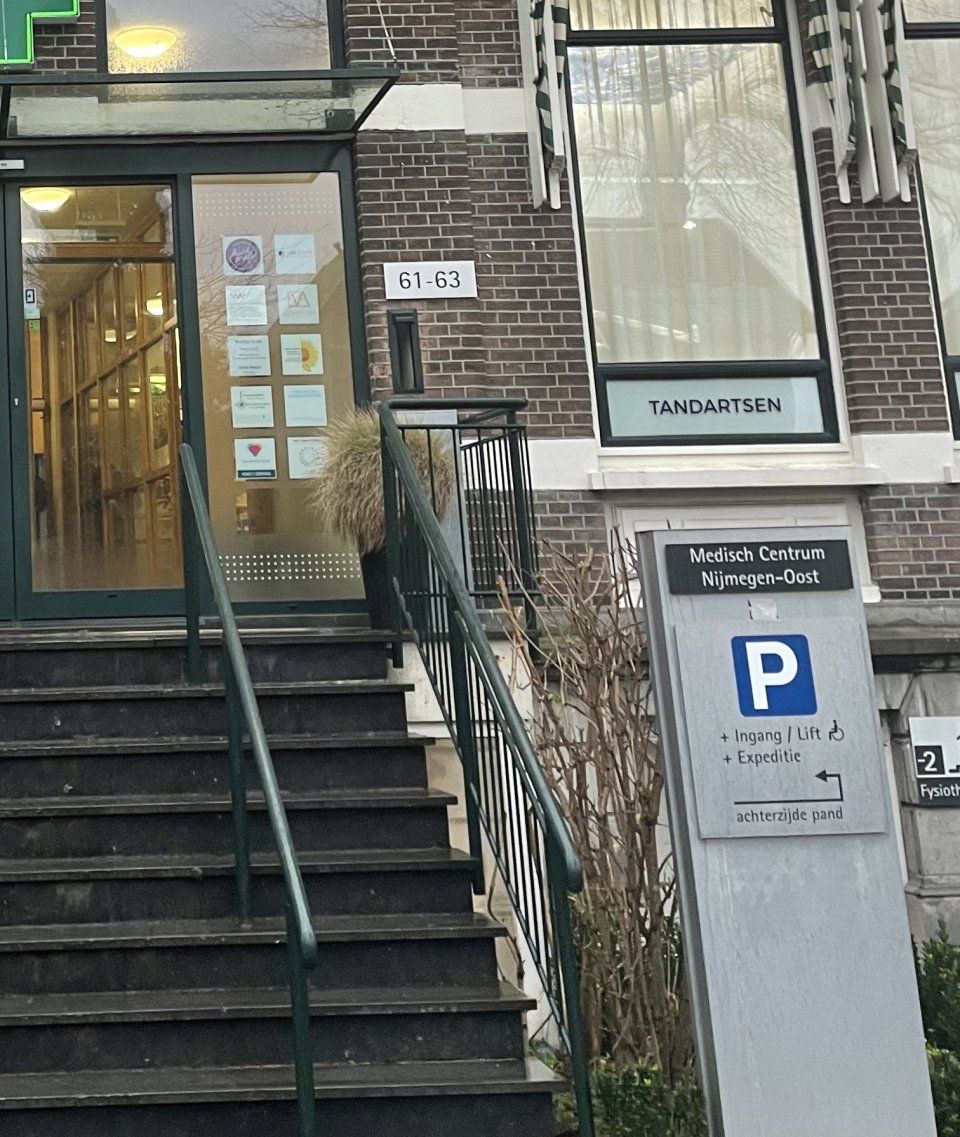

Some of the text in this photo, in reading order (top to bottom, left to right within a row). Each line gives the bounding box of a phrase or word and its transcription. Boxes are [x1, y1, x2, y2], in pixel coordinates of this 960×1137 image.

[399, 270, 461, 289] 61-63
[648, 397, 782, 415] TANDARTSEN
[690, 545, 825, 564] Medisch Centrum
[701, 568, 820, 590] Nijmegen-Oost
[745, 640, 798, 710] P
[735, 729, 782, 745] Ingang
[797, 726, 822, 741] Lift
[738, 749, 801, 767] Expeditie
[917, 750, 938, 772] -2
[737, 807, 843, 825] achterzijde pand
